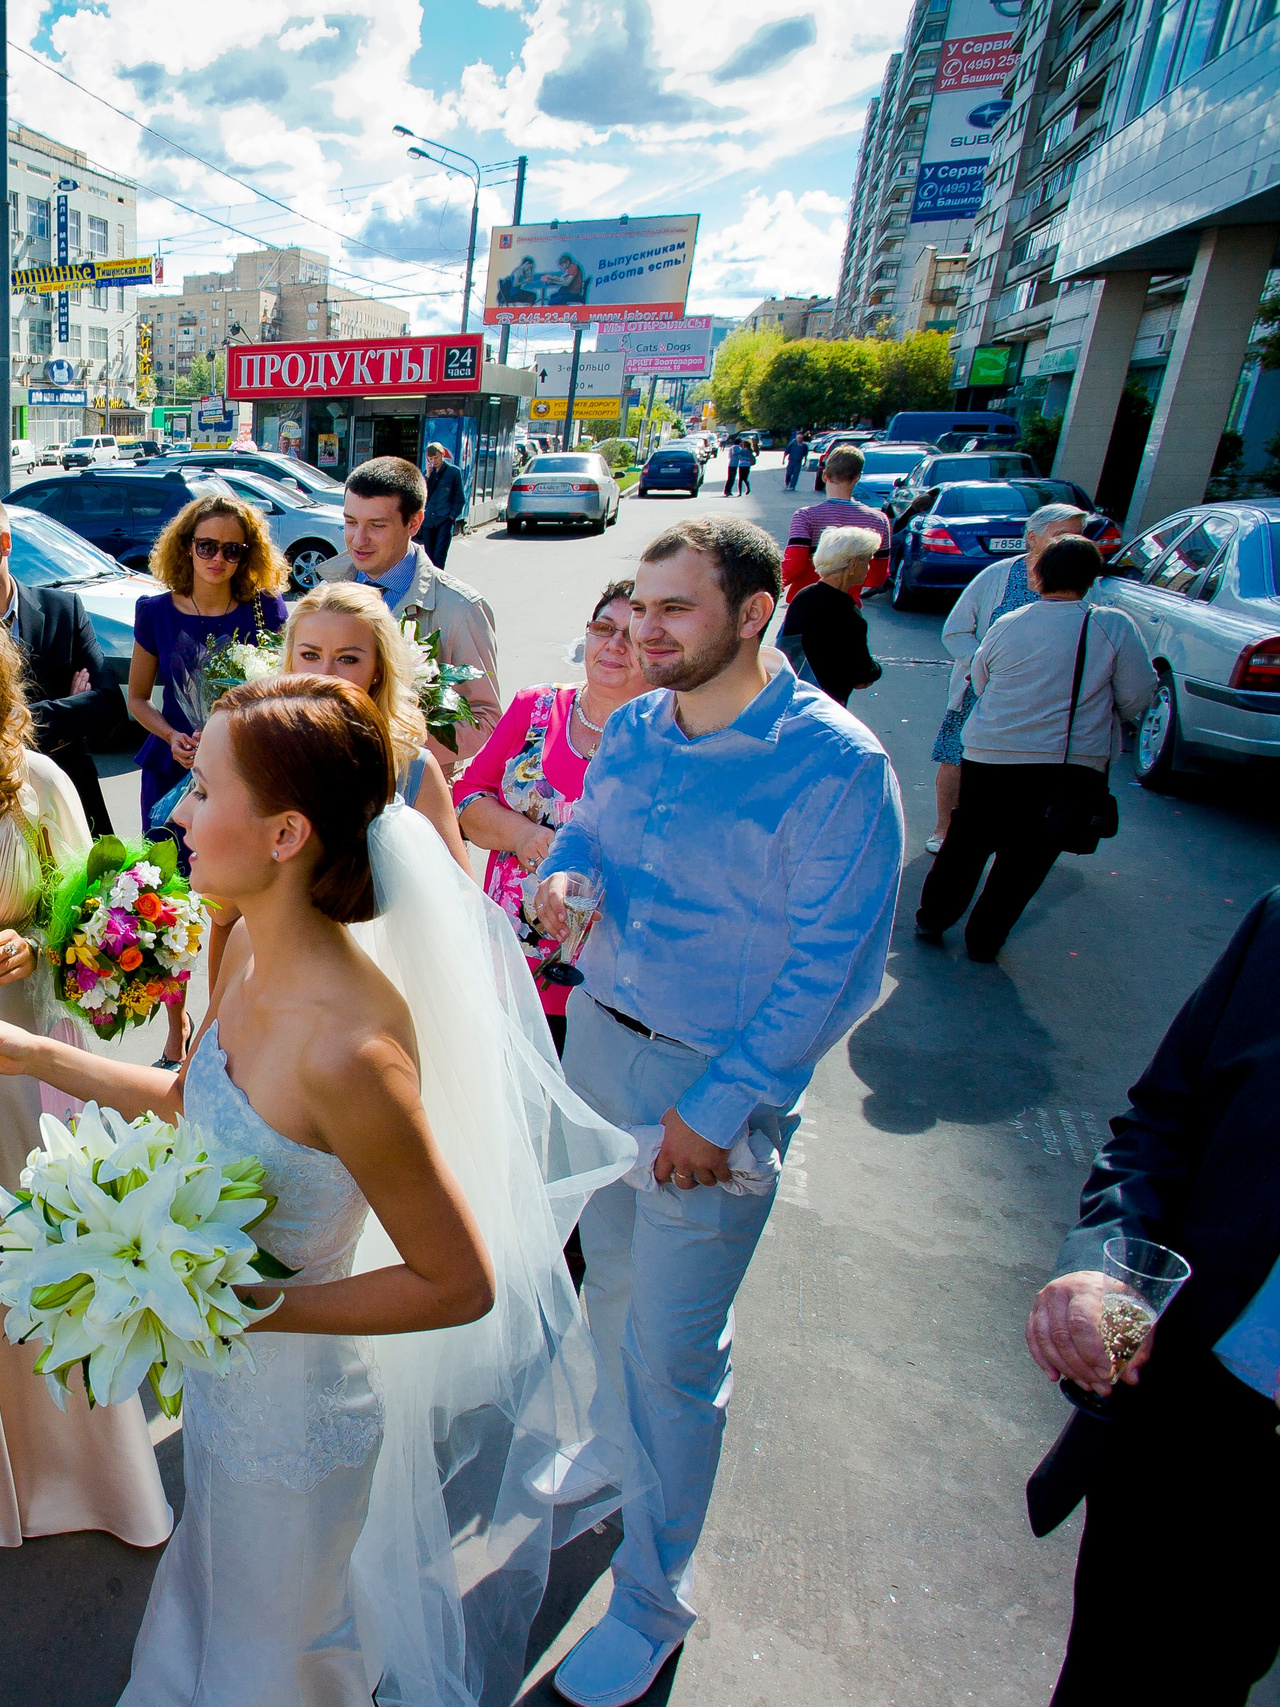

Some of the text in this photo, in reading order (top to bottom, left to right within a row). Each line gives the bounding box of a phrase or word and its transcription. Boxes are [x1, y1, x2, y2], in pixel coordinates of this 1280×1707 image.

[962, 38, 1012, 55] Серви
[963, 57, 995, 74] (495)
[940, 71, 1008, 89] ул. Башило
[938, 164, 988, 179] Серви
[939, 181, 971, 196] (495)
[917, 195, 982, 210] ул. Башило
[59, 232, 67, 258] МАМ
[598, 240, 686, 270] Выпускникам
[96, 266, 136, 277] Тишинская
[595, 253, 687, 287] работа есть!
[60, 290, 68, 341] АЛЫШЕЙ
[589, 309, 674, 322] www.labor.ru
[603, 322, 624, 333] МЫ
[626, 318, 707, 332] ОТКРЫЛИСЬ!
[636, 341, 692, 354] Cats&Dogs
[238, 346, 473, 392] ПРОДУКТЫ 24
[578, 363, 611, 373] ОЛЬЦО
[627, 358, 654, 367] АРКЕТ
[447, 366, 471, 377] часа
[95, 397, 125, 409] ХИИНА
[588, 400, 617, 409] ДОРОГУ
[993, 539, 1026, 549] Т858
